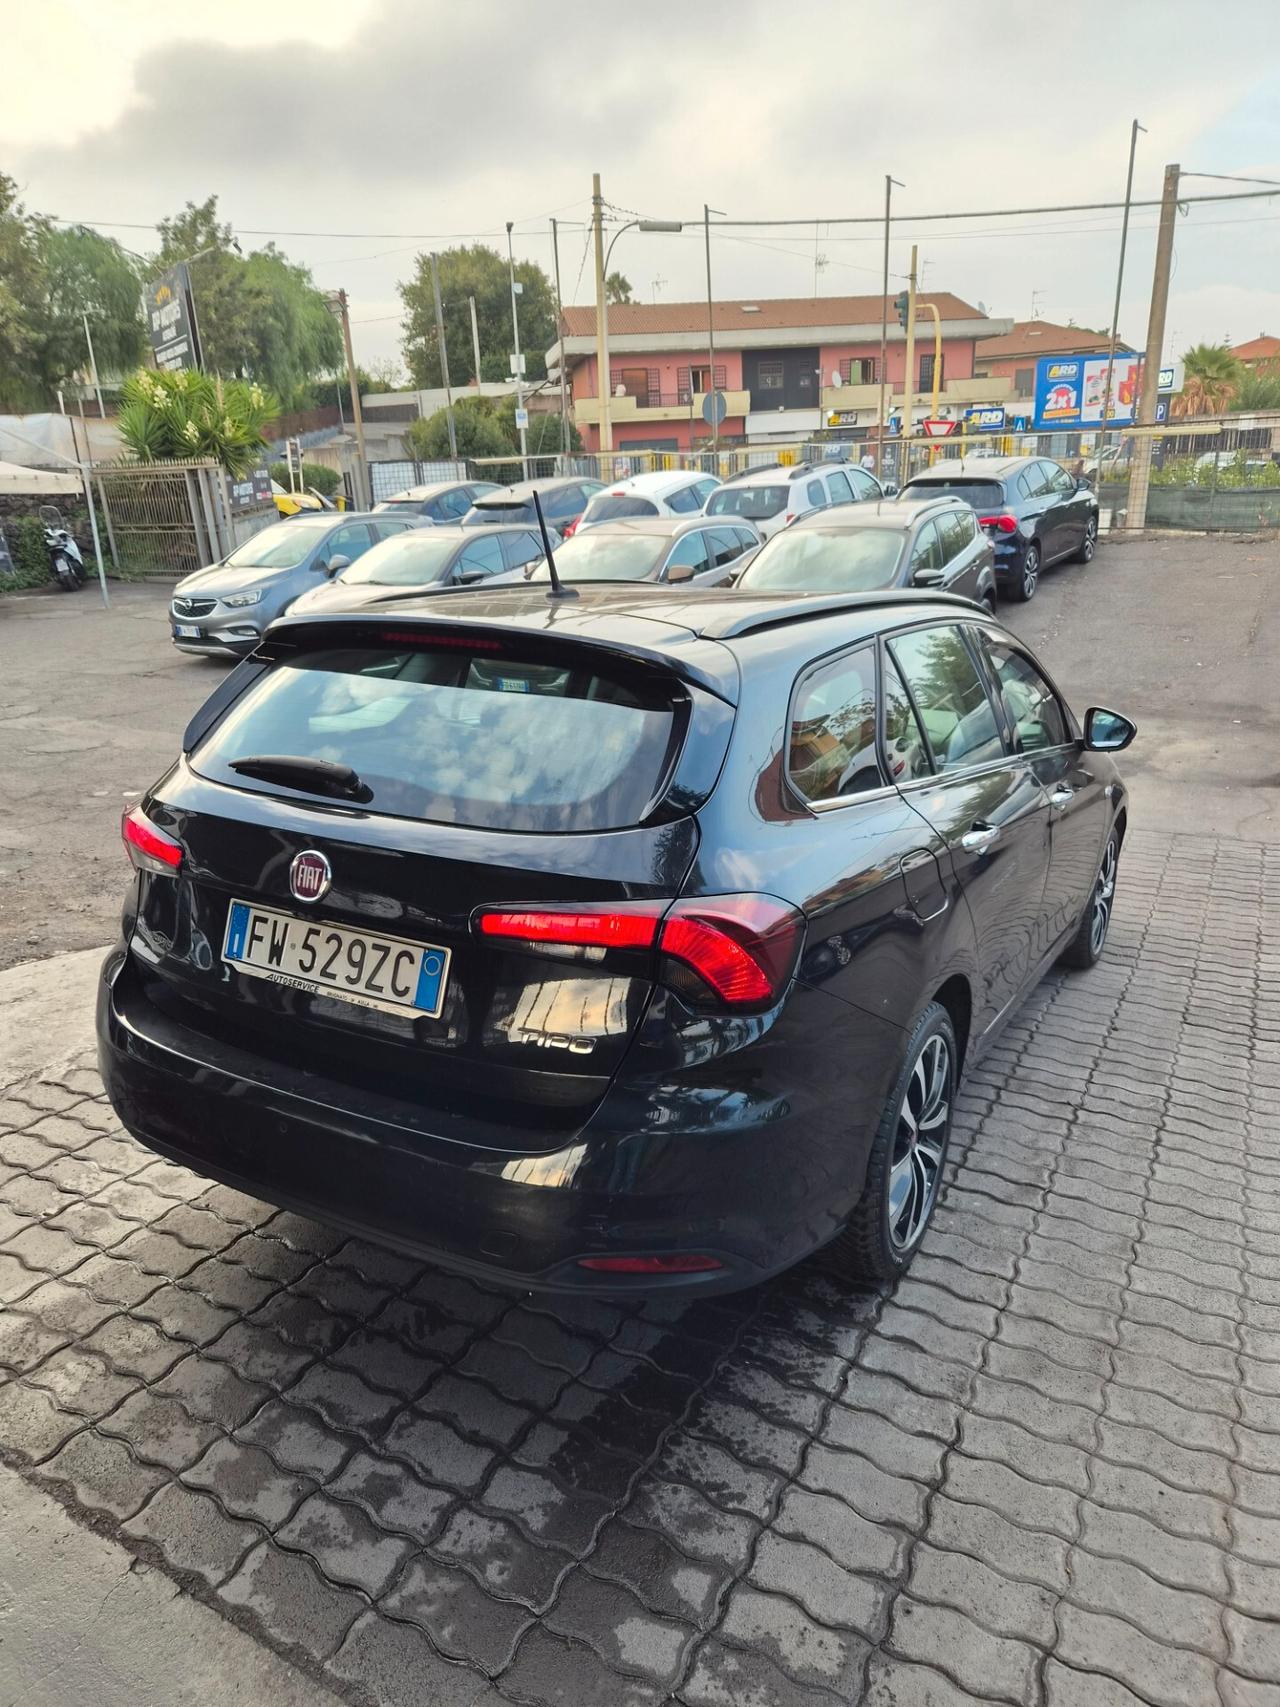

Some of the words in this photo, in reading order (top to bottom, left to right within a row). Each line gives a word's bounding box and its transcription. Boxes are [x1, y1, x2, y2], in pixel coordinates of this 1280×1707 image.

[1049, 364, 1077, 378] ARD
[1159, 371, 1173, 384] RD
[829, 413, 857, 425] ARD
[970, 411, 1003, 424] ARD
[1157, 405, 1164, 420] P
[297, 864, 322, 890] FIAT
[247, 915, 289, 967] FW
[298, 927, 415, 998] 529ZC
[265, 973, 320, 993] AUTOSERVICE
[517, 1027, 597, 1054] TIPO
